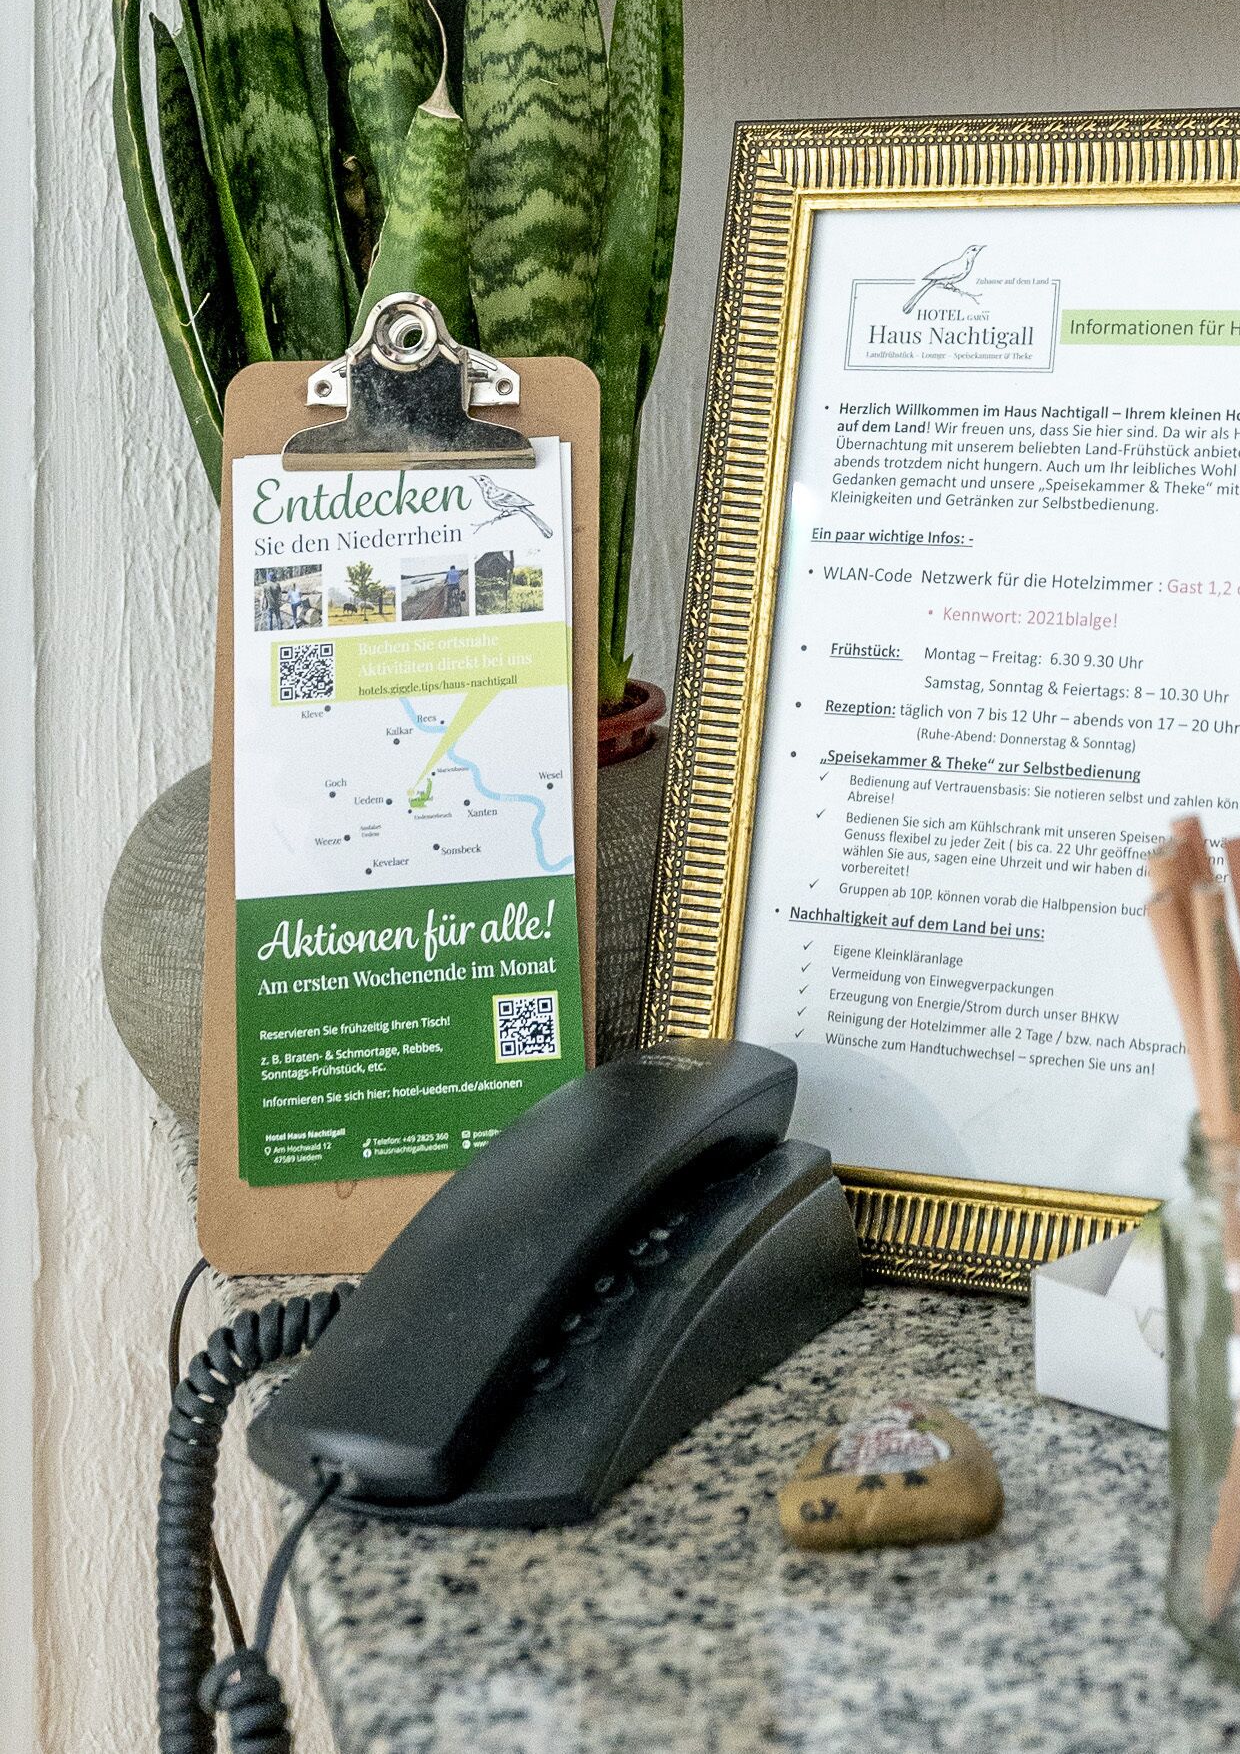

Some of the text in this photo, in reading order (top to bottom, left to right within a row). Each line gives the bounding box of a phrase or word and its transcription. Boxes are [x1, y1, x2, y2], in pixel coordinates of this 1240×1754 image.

[917, 308, 966, 322] HOTEL
[868, 325, 1034, 348] Haus Nachtigall
[1070, 318, 1194, 336] Informationen
[1199, 319, 1225, 336] für
[836, 419, 860, 437] auf
[861, 420, 891, 433] dem
[894, 421, 931, 434] Land!
[934, 422, 958, 434] Wir
[961, 421, 1005, 435] freuen
[1008, 426, 1035, 438] uns,
[1039, 423, 1069, 437] dass
[1072, 424, 1093, 437] Sie
[1095, 424, 1123, 438] hier
[1126, 425, 1158, 439] sind.
[1162, 425, 1181, 439] Da
[1184, 426, 1207, 439] wir
[1210, 427, 1230, 440] als
[835, 436, 928, 455] Übernachtung
[930, 440, 953, 452] mit
[956, 443, 1014, 453] unserem
[1018, 441, 1081, 455] beliebten
[1085, 443, 1190, 457] Land-Frühstück
[833, 455, 881, 468] abends
[883, 456, 943, 470] trotzdem
[946, 457, 980, 471] nicht
[983, 458, 1042, 475] hungern.
[1045, 460, 1081, 473] Auch
[1084, 463, 1106, 474] um
[1109, 460, 1130, 474] Ihr
[1132, 461, 1197, 476] leibliches
[1200, 463, 1237, 477] Wohl
[252, 470, 472, 526] Entdecken
[830, 491, 1159, 515] Kleinigkeiten und Getränken zur Selbstbedienung.
[254, 524, 462, 556] Sie den Niederrhein
[942, 607, 1022, 624] Kennwort:
[357, 634, 499, 656] Buchen Sie ortsnahe
[830, 642, 902, 661] Frühstück:
[358, 653, 533, 678] Aktivitäten direkt bei uns
[358, 675, 518, 696] hotels.giggle.tips/haus-nachtigall
[300, 707, 325, 719] Kleve
[415, 714, 437, 725] Rees
[385, 726, 413, 736] Kalkar
[916, 727, 1136, 754] (Ruhe-Abend: Donnerstag & Sonntag)
[538, 770, 564, 780] Wesel
[819, 748, 1142, 783] „Speisekammer & Theke“ zur Selbstbedienung
[324, 778, 348, 788] Goch
[353, 795, 384, 805] Uedem
[467, 808, 498, 818] Xanten
[314, 837, 342, 846] Weeze
[441, 844, 482, 856] Sonsbeck
[372, 857, 410, 868] Kevelaer
[257, 899, 555, 961] Aktionen für alle!
[258, 957, 557, 996] Am ersten Wochenende im Monat
[831, 966, 1054, 998] Vermeidung von Einwegverpackungen
[259, 1016, 451, 1040] Reservieren Sie frühzeitig Ihren Tisch!
[260, 1042, 444, 1066] z. B. Braten- & Schmortage, Rebbes,
[260, 1062, 387, 1081] Sonntags-Frühstück, etc.
[262, 1079, 523, 1108] Informieren Sie sich hier: hotel-uedem.de/aktionen
[265, 1128, 346, 1142] Hotel Haus Nachtigall
